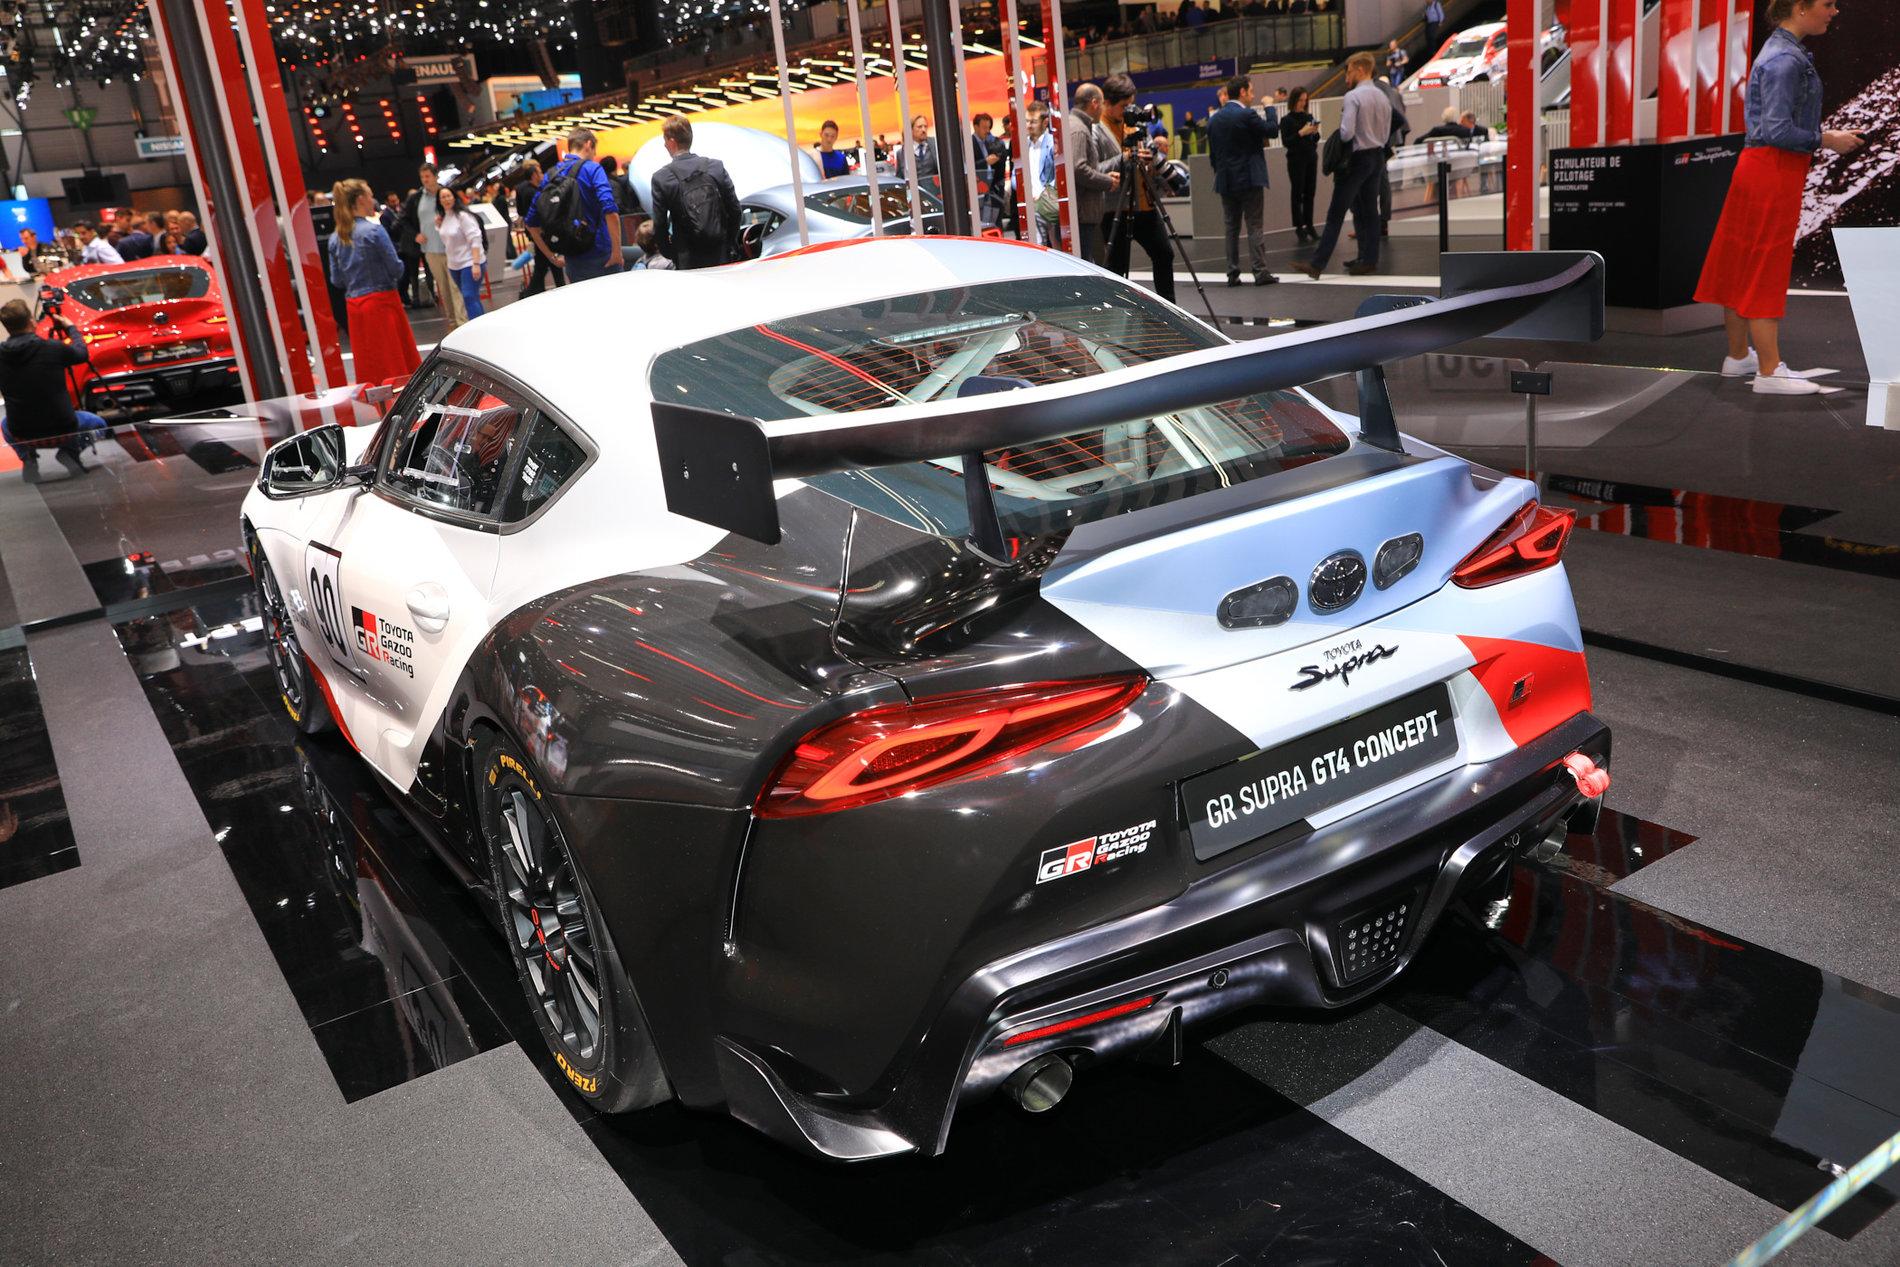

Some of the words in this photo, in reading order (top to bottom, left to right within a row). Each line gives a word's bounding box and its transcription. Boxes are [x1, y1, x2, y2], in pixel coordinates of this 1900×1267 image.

[1554, 157, 1606, 169] SIMULATEUR
[1609, 156, 1621, 167] DE
[1554, 170, 1594, 182] PILOTAGE
[310, 566, 347, 657] 90
[354, 622, 380, 660] GR
[379, 618, 414, 643] TOYOTA
[381, 635, 412, 658] GAZOO
[1323, 639, 1362, 661] TOYOTA
[382, 650, 414, 678] Racing
[1288, 644, 1399, 692] Supra
[500, 755, 541, 800] PIRELLI
[1206, 794, 1237, 829] GR
[1239, 765, 1307, 815] SUPRA
[1311, 747, 1350, 785] GT4
[1353, 710, 1438, 768] CONCEPT
[1096, 831, 1150, 855] GAZOO
[1098, 820, 1156, 844] TOYOTA
[1039, 848, 1093, 881] GR
[1094, 841, 1148, 865] Racing
